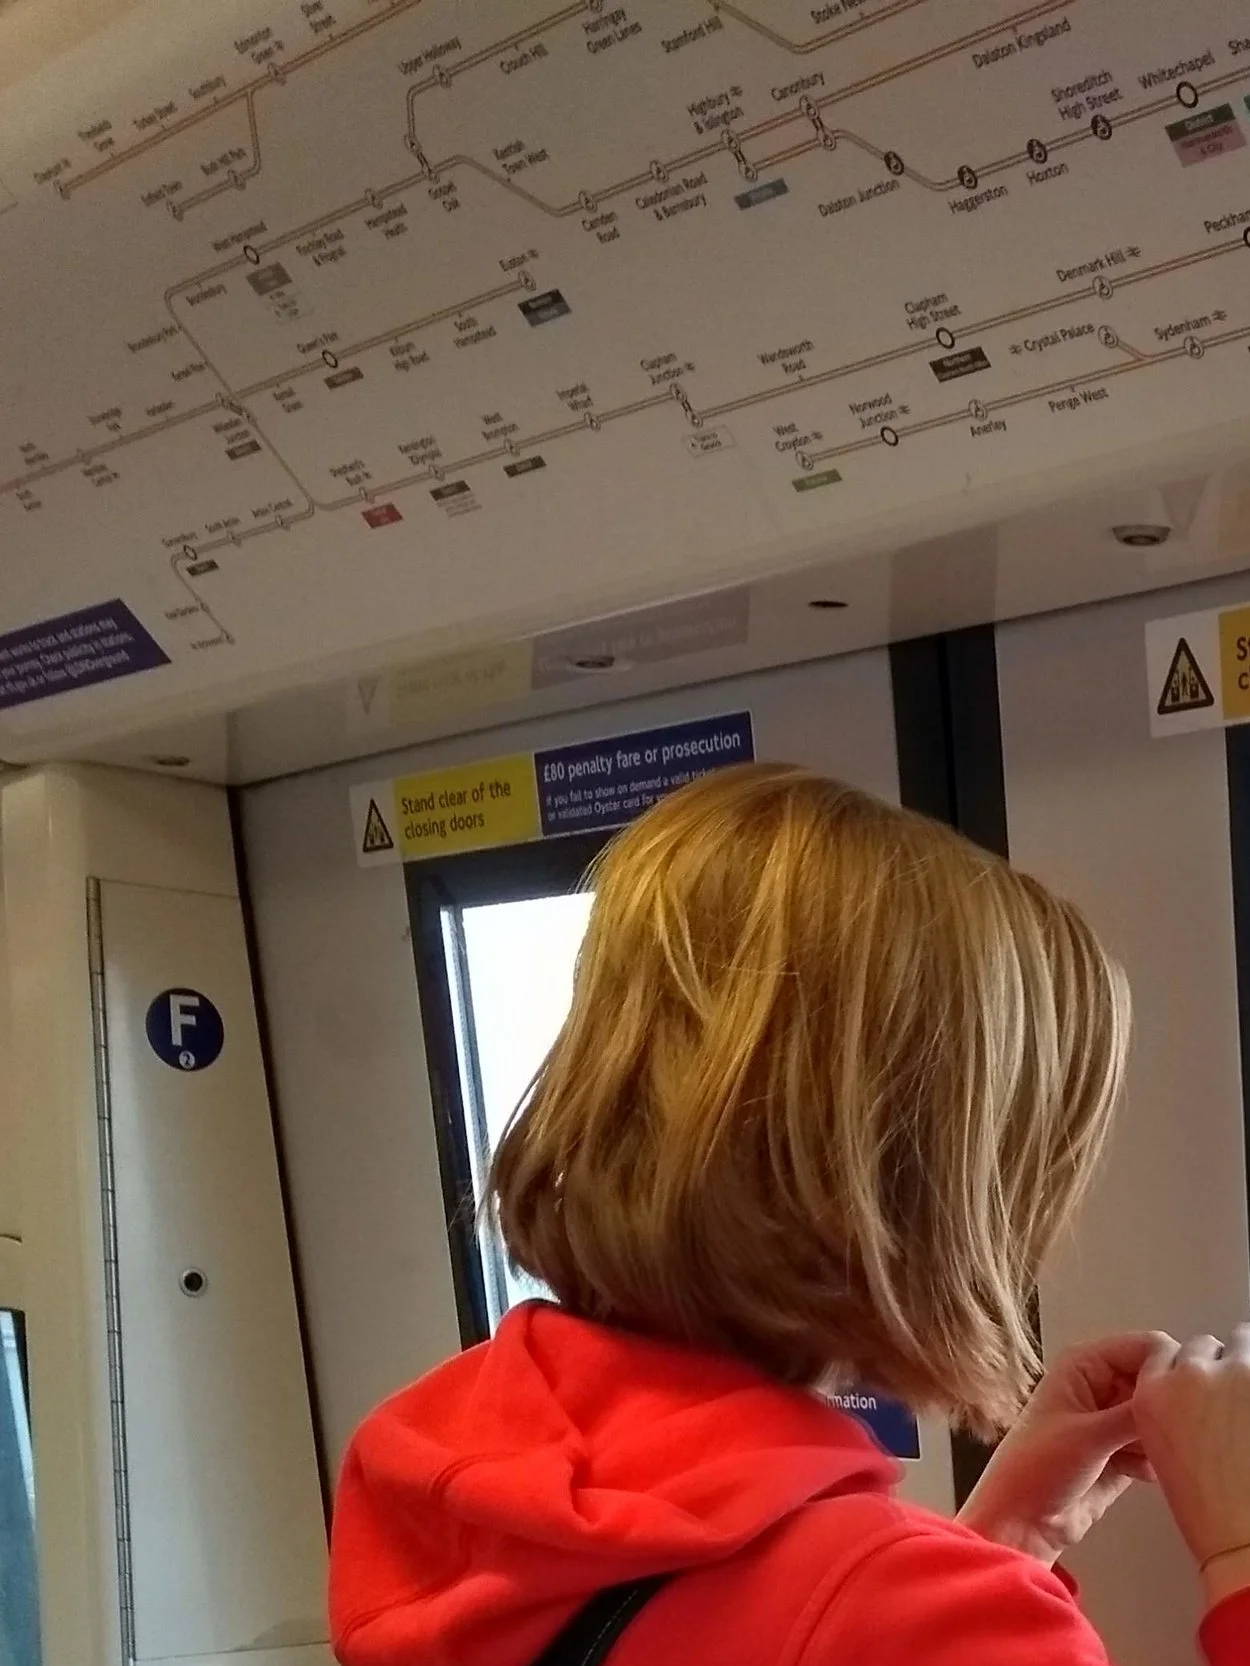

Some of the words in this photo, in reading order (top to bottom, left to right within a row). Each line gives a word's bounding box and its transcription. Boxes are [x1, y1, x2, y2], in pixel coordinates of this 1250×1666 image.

[1137, 49, 1216, 90] Whitechapel
[1050, 70, 1113, 103] Shoreditch
[1057, 101, 1086, 121] High
[1026, 162, 1070, 187] Hoxton
[1056, 256, 1106, 282] Denmark
[1153, 315, 1212, 342] Sydenham
[1048, 395, 1081, 414] Penge
[543, 761, 565, 783] £80
[568, 754, 613, 782] penalty
[616, 749, 641, 769] fare
[644, 749, 658, 767] or
[661, 731, 742, 766] prosecution
[401, 791, 436, 816] Stand
[438, 789, 468, 809] clear
[471, 781, 485, 803] of
[488, 780, 512, 800] the
[404, 817, 448, 841] closing
[449, 812, 485, 833] doors
[169, 993, 201, 1047] F
